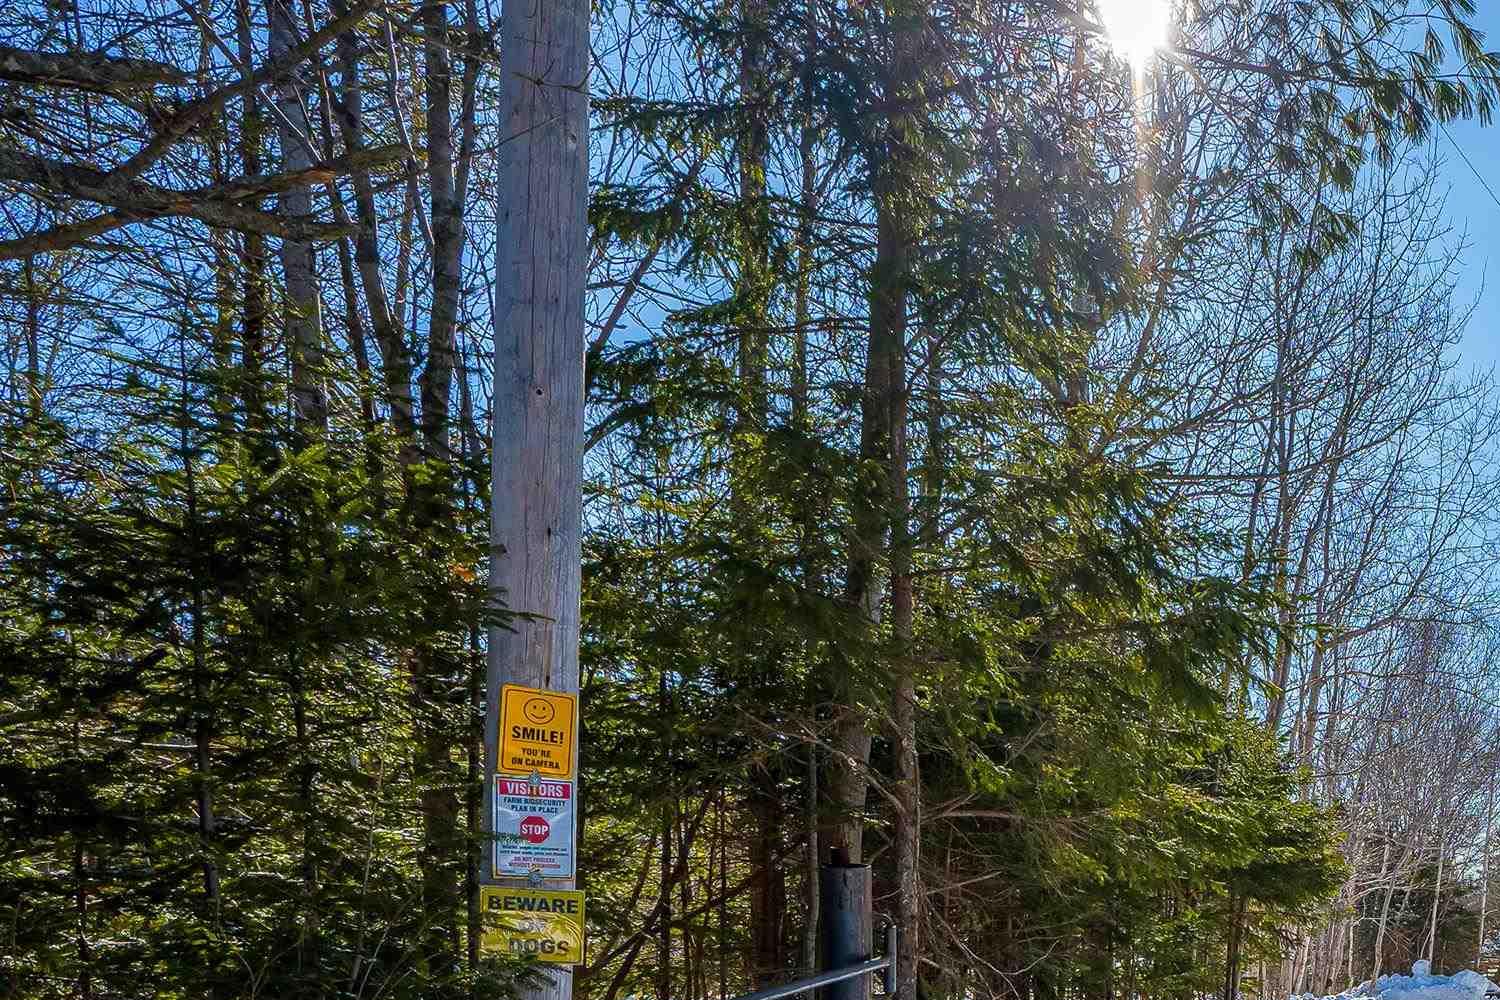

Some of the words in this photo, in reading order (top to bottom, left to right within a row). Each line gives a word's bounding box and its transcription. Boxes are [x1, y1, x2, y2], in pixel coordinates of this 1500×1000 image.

[512, 726, 564, 744] SMILE!
[521, 747, 552, 758] YOU'RE
[511, 757, 523, 765] ON
[525, 758, 560, 769] CAMERA
[506, 782, 563, 797] VISITORS
[538, 806, 558, 814] PLACE
[521, 824, 549, 836] STOP
[488, 895, 578, 914] BEWARE
